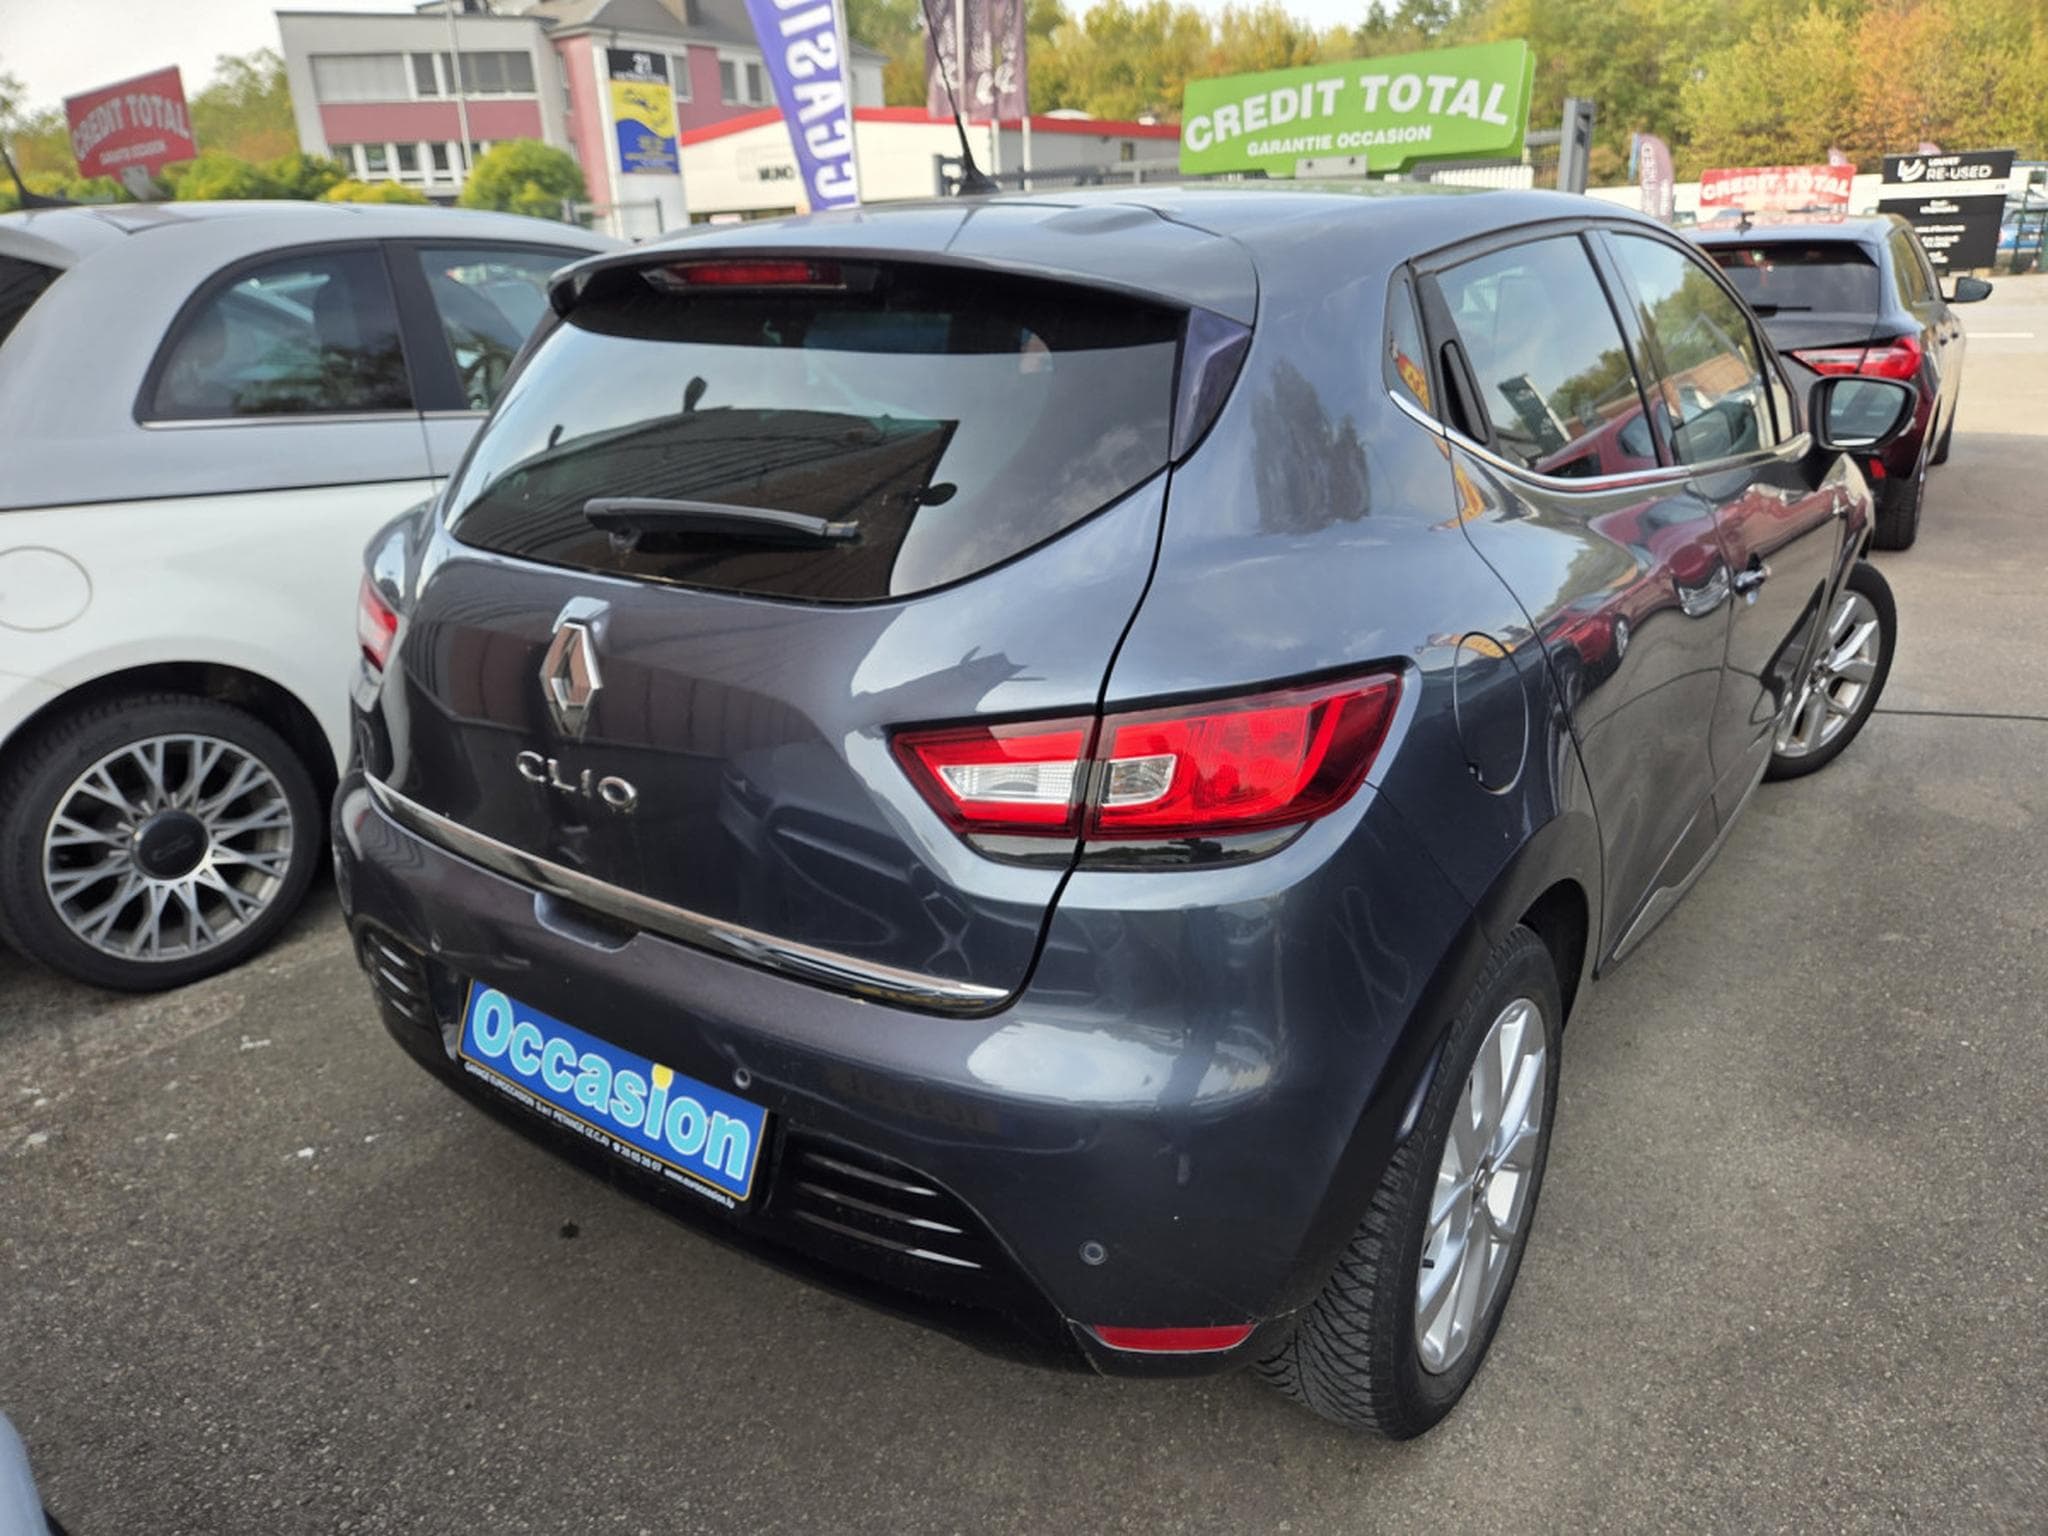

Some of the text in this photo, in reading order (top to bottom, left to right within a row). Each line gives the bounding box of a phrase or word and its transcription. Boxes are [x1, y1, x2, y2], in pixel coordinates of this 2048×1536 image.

[125, 94, 191, 139] TOTAL
[1184, 73, 1510, 153] CREDIT TOTAL
[1246, 124, 1433, 158] GARANTIE OCCASION
[1701, 173, 1780, 201] CREDIT
[1785, 170, 1850, 197] TOTAL
[1926, 164, 1993, 181] RE-USED
[515, 750, 638, 812] CLIO
[471, 987, 751, 1182] Occasion
